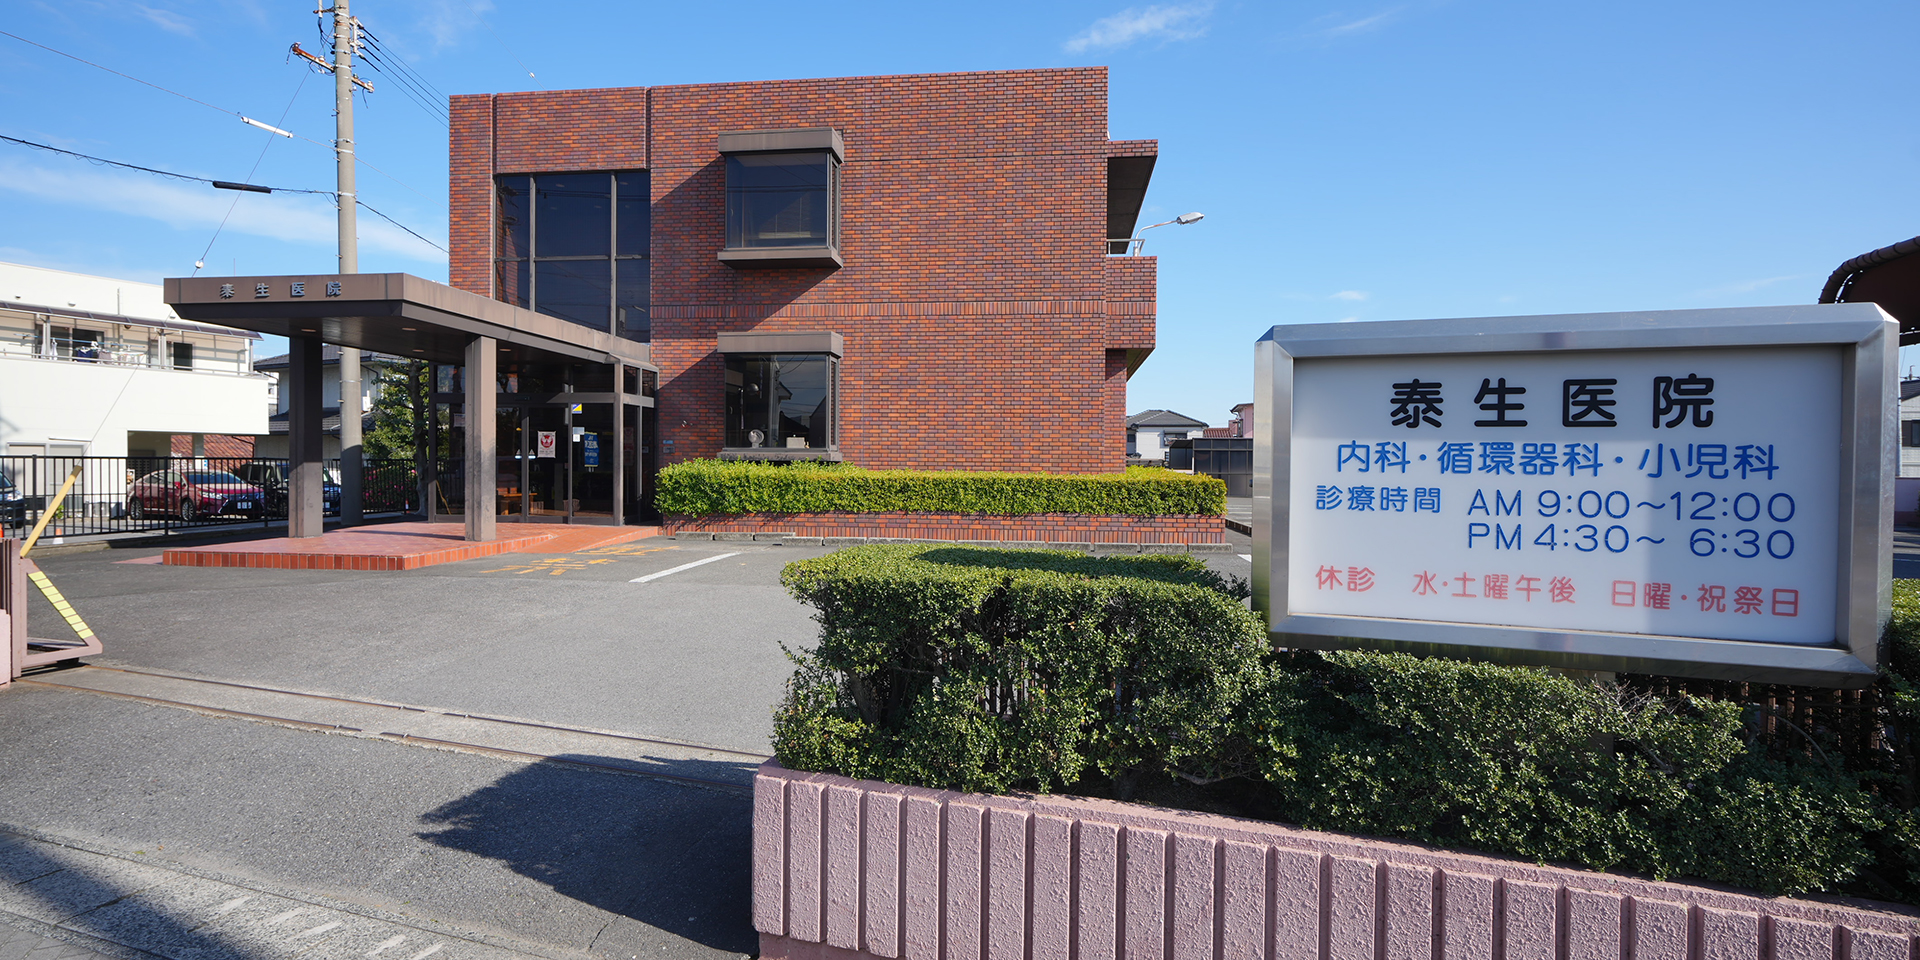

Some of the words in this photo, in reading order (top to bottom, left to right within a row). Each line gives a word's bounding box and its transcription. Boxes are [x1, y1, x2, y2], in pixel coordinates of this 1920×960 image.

[219, 281, 342, 299] 泰生医院
[1389, 372, 1715, 429] 泰生医院
[1337, 439, 1781, 481] 内科・循環器科・小児科
[1315, 484, 1442, 514] 診療時間
[1467, 488, 1523, 517] AM
[1468, 522, 1523, 551] PM
[1689, 527, 1796, 560] 6:30
[1315, 564, 1376, 593] 休診
